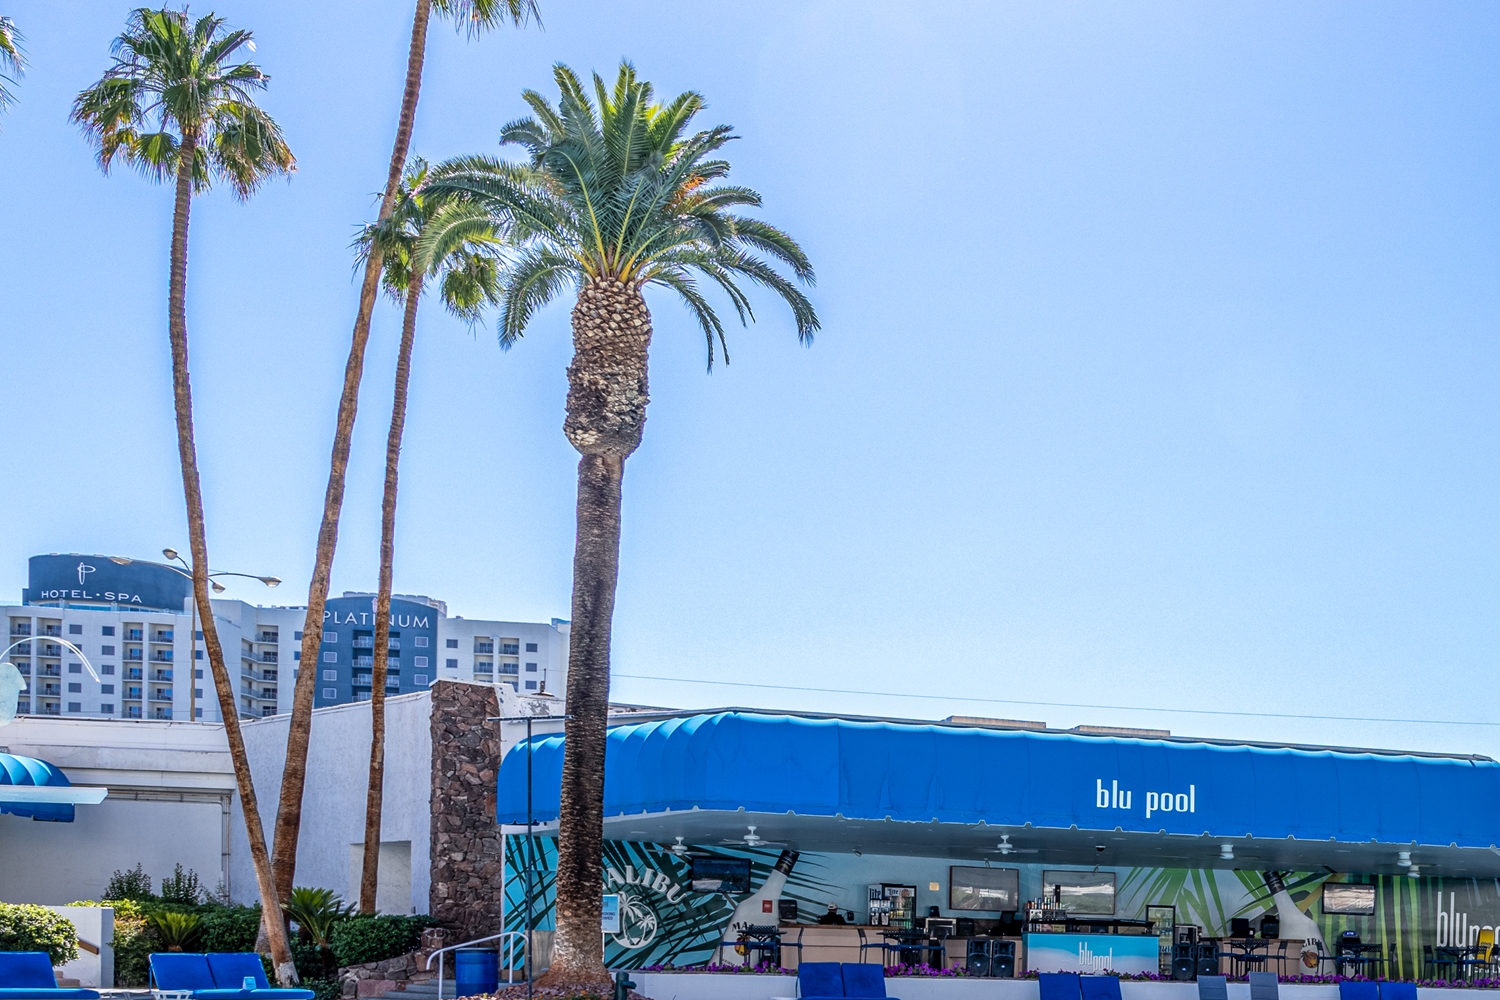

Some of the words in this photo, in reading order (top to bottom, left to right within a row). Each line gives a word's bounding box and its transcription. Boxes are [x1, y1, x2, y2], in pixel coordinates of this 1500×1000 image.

[41, 589, 93, 599] HOTEL
[104, 591, 142, 603] SPA
[1096, 778, 1132, 809] blu
[1145, 784, 1195, 819] pool
[602, 864, 687, 905] ALIBU
[1436, 891, 1468, 948] blu
[1079, 941, 1093, 966] blu
[1092, 947, 1113, 973] pool
